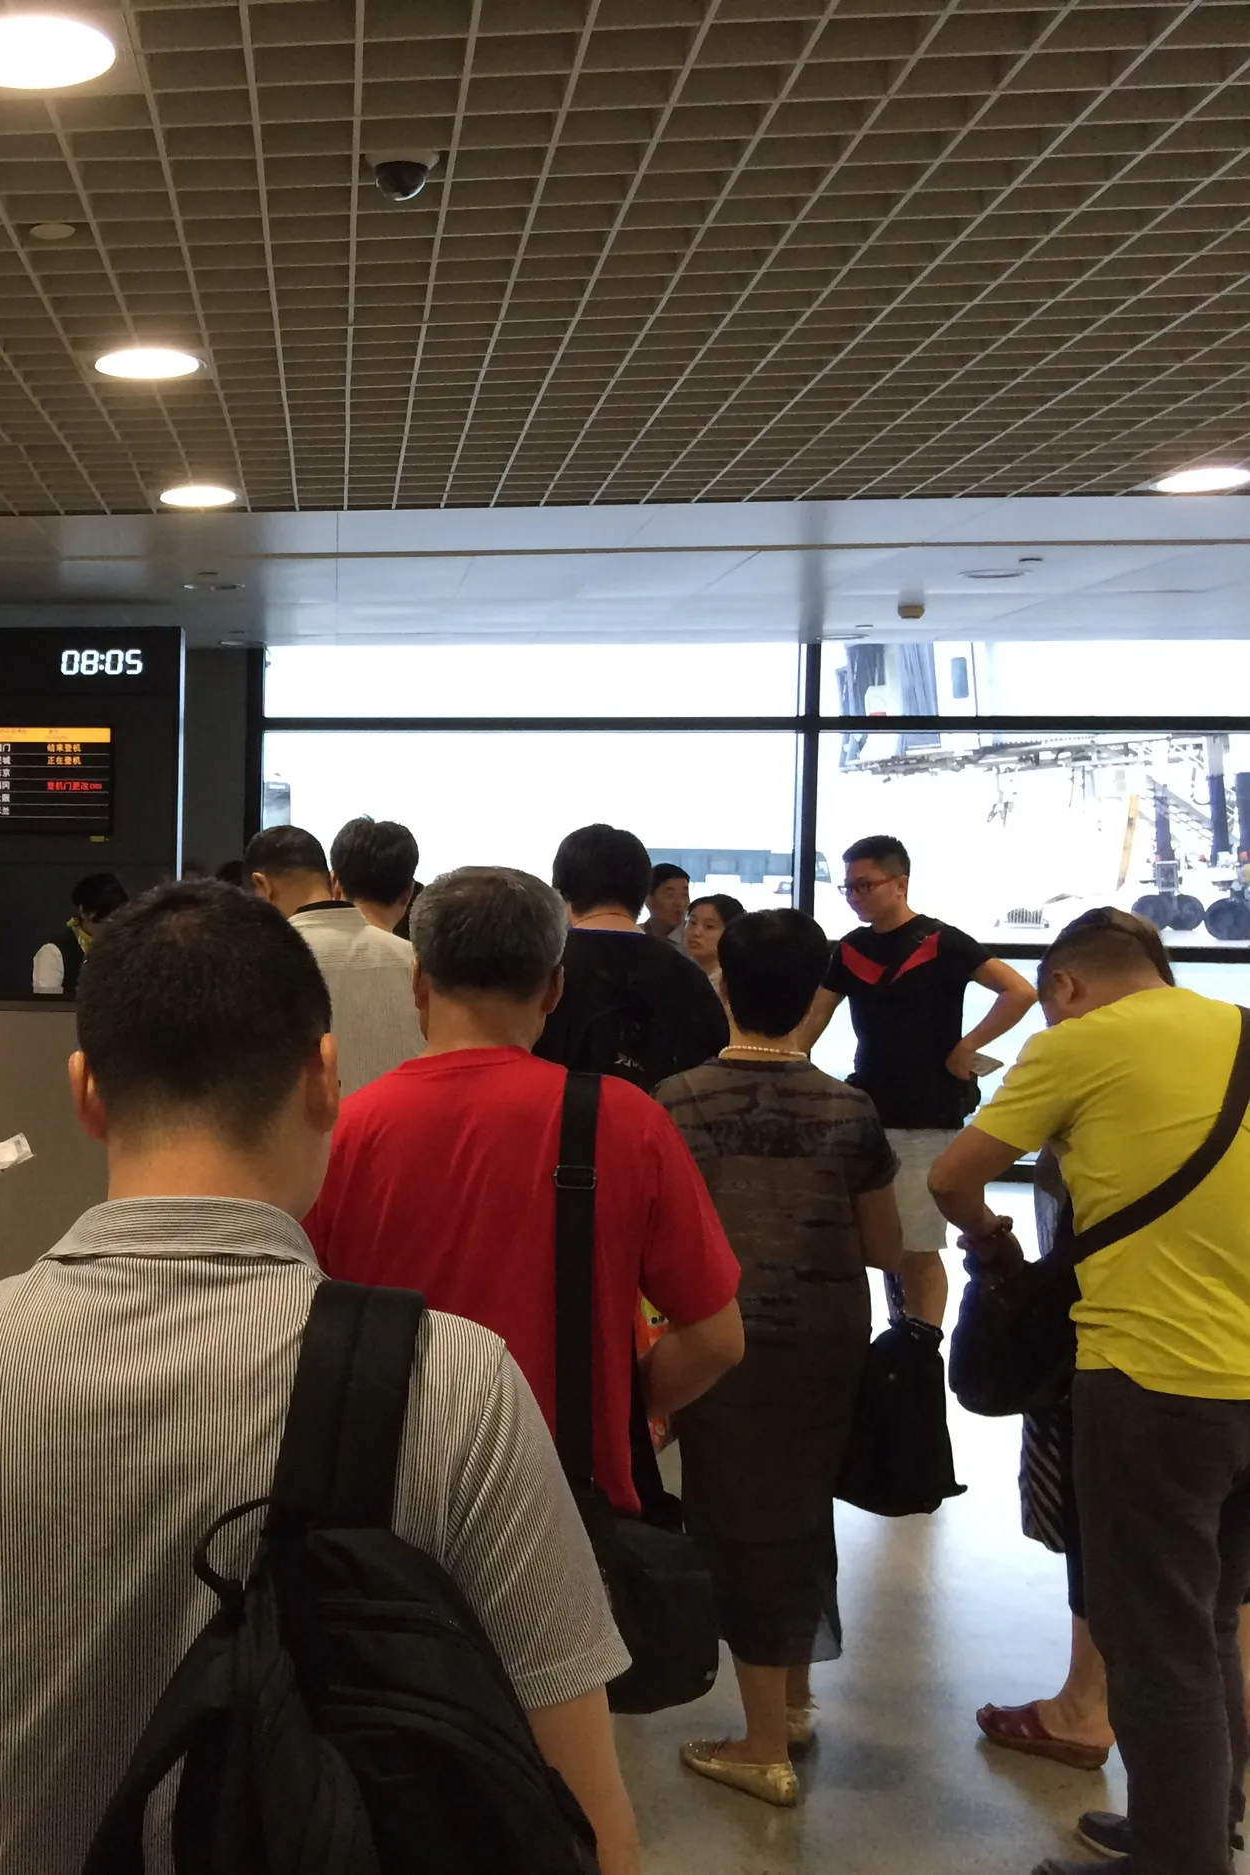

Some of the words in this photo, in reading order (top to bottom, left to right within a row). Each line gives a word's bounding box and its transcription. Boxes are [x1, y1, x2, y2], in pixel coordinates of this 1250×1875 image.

[60, 648, 143, 676] 08:05
[46, 756, 82, 765] 正在登机
